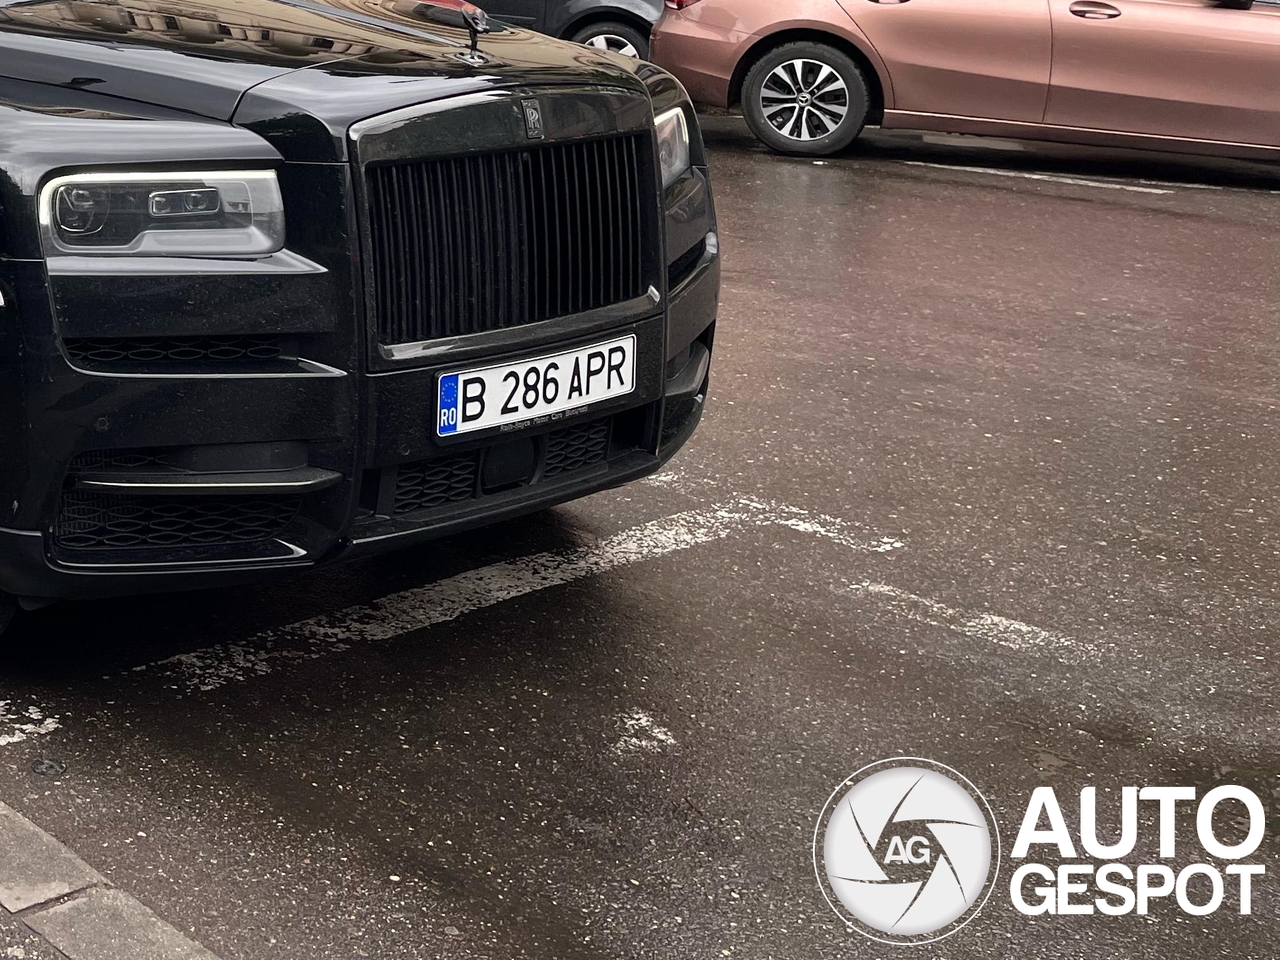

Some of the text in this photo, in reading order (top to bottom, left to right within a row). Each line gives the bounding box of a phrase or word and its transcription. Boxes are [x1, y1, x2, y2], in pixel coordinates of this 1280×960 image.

[461, 345, 626, 423] B 286 APR
[440, 407, 457, 427] RO
